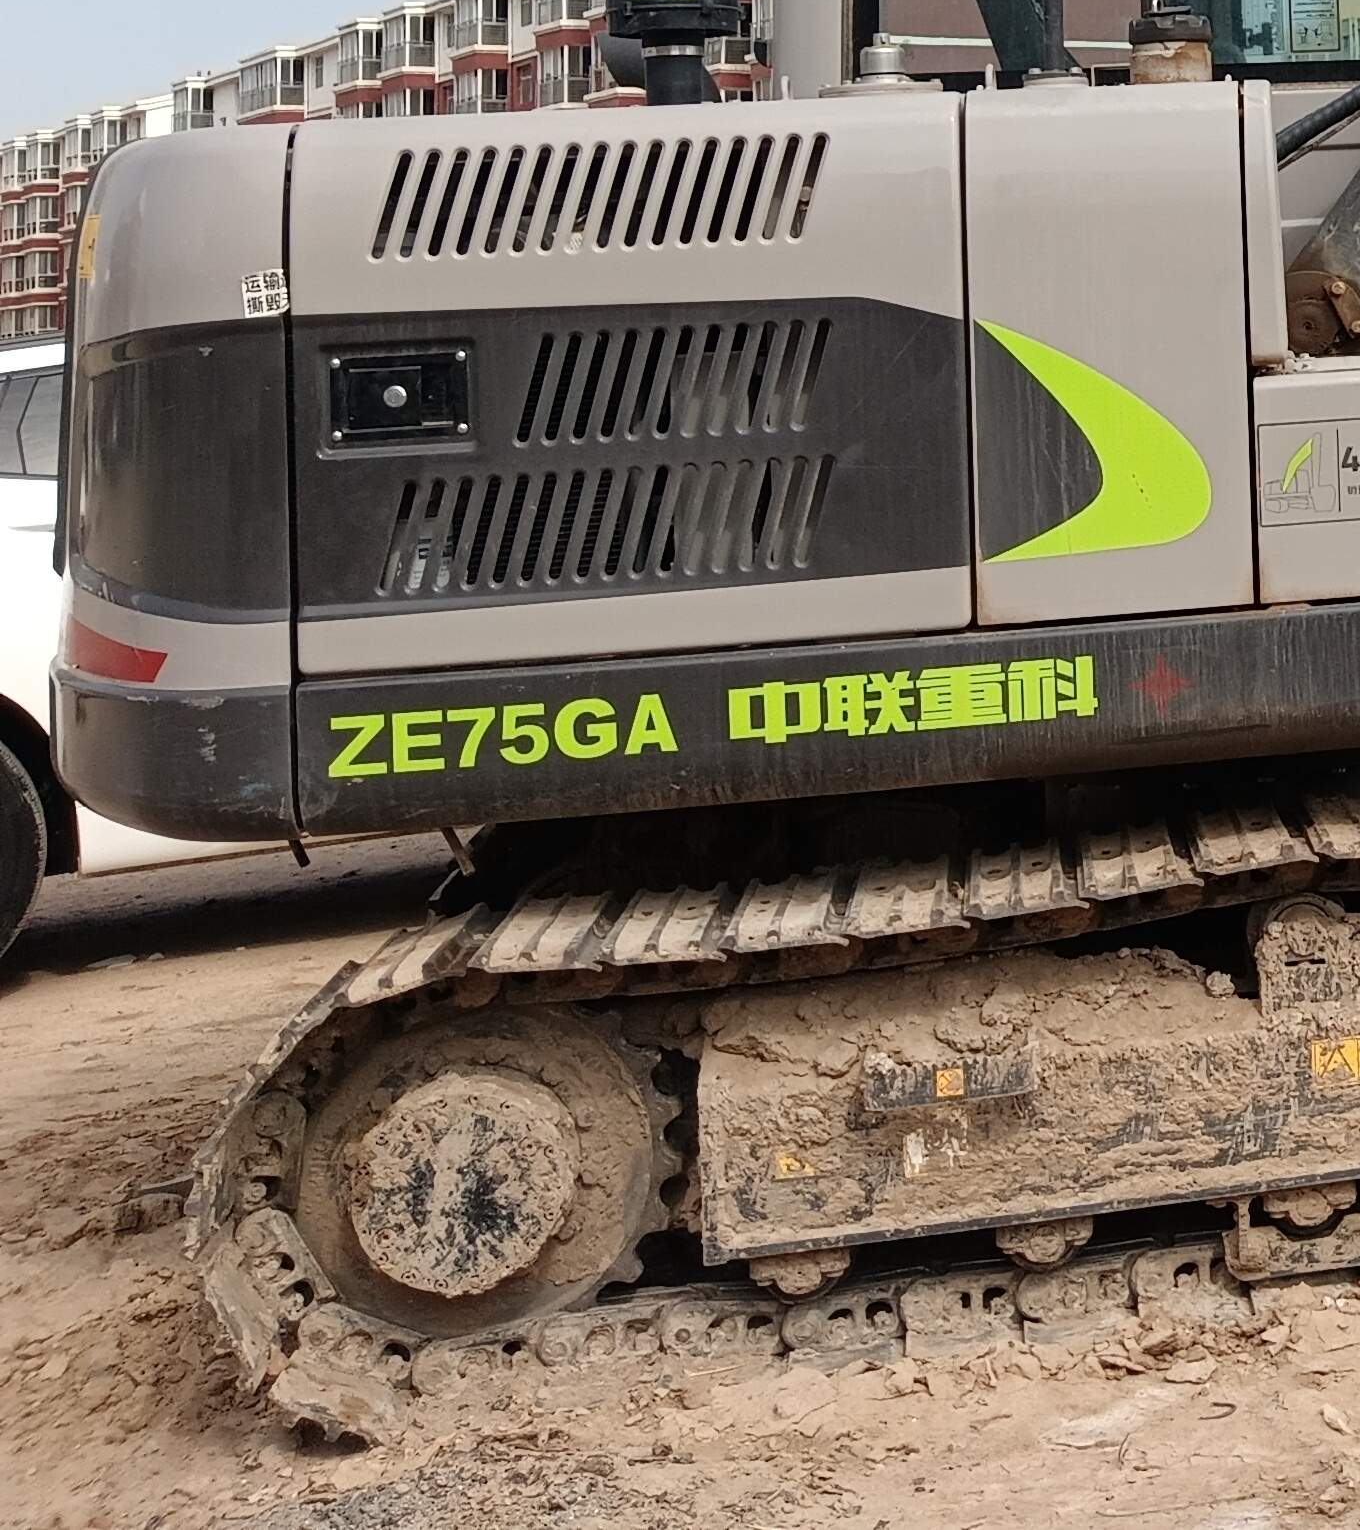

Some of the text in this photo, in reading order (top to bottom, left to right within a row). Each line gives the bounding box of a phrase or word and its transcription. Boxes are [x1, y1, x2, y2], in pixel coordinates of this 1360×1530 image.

[328, 693, 679, 778] ZE75GA
[728, 655, 1099, 744] 中联重科
